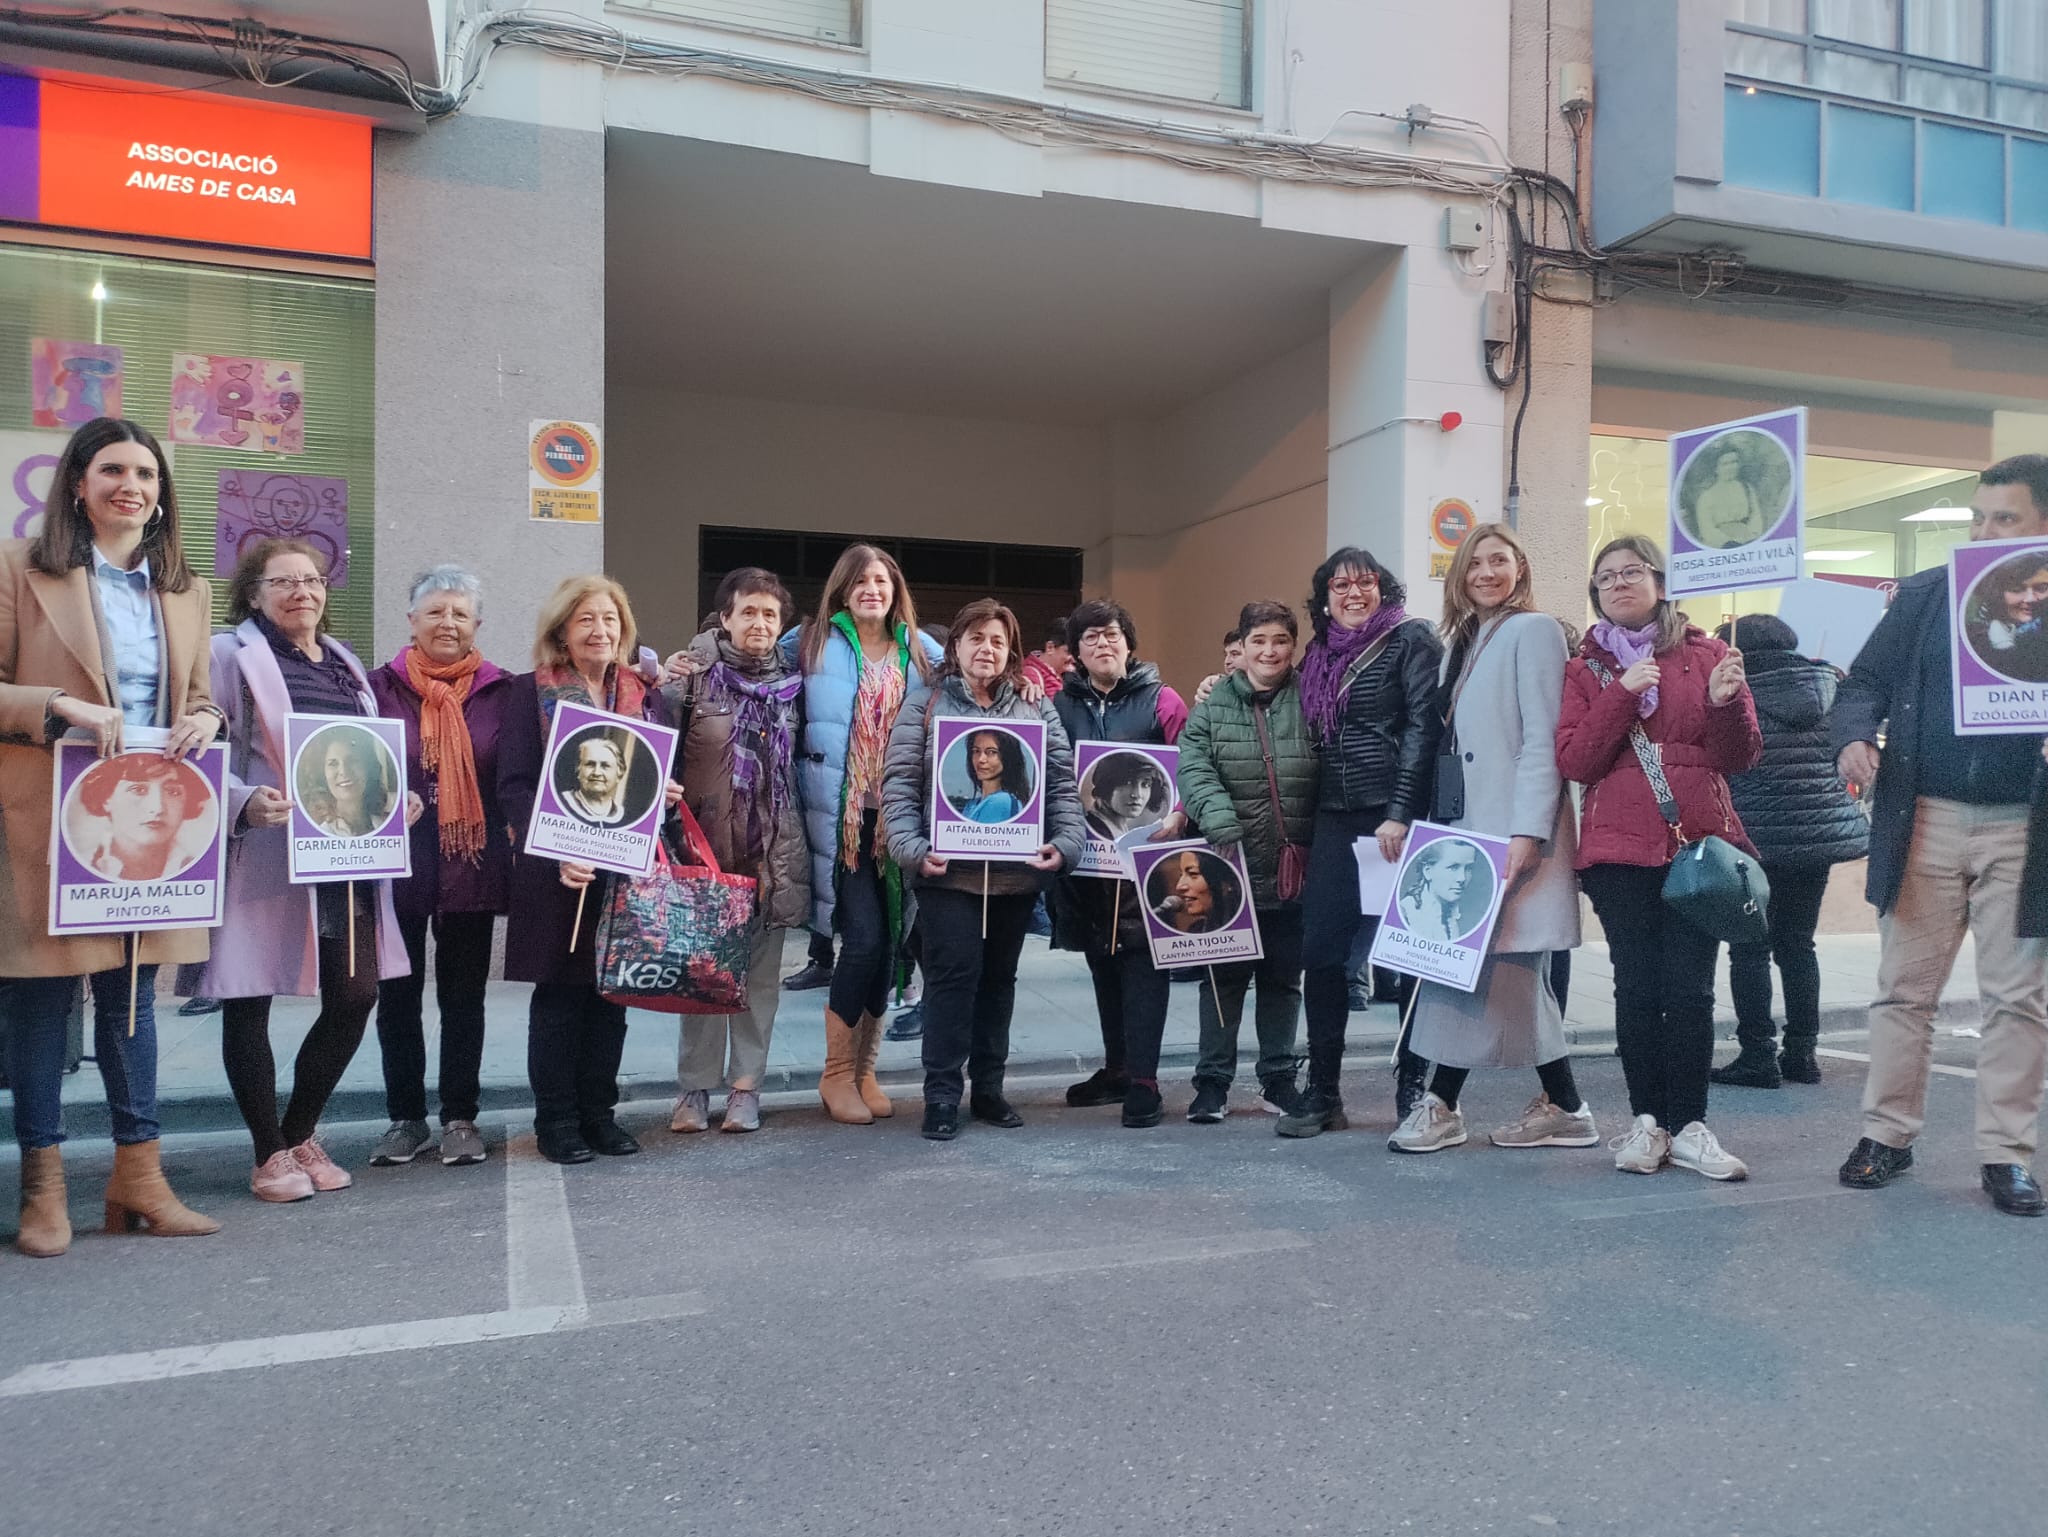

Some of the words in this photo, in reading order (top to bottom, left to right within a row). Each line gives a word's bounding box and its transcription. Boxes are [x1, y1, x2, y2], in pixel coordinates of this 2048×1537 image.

[127, 142, 278, 175] ASSOCIACIÓ
[125, 171, 196, 194] AMES
[200, 179, 232, 198] DE
[236, 183, 297, 206] CASA
[1673, 560, 1705, 572] ROSA
[1707, 551, 1755, 567] SENSAT
[1988, 690, 2035, 703] DIAN
[540, 816, 577, 832] MARIA
[579, 824, 648, 847] MONTESSORI
[945, 825, 982, 834] AITANA
[984, 826, 1030, 836] BONMATÍ
[296, 840, 346, 851] CARMEN
[349, 838, 401, 849] ALBORCH
[330, 855, 375, 865] POLÍTICA
[70, 886, 142, 901] MARUJA
[146, 884, 206, 898] MALLO
[106, 905, 171, 918] PINTORA
[1171, 940, 1196, 950] ANA
[1197, 935, 1236, 948] TIJOUX
[1388, 931, 1410, 946] ADA
[1412, 938, 1467, 961] LOVELACE
[1161, 951, 1196, 960] CANTANT
